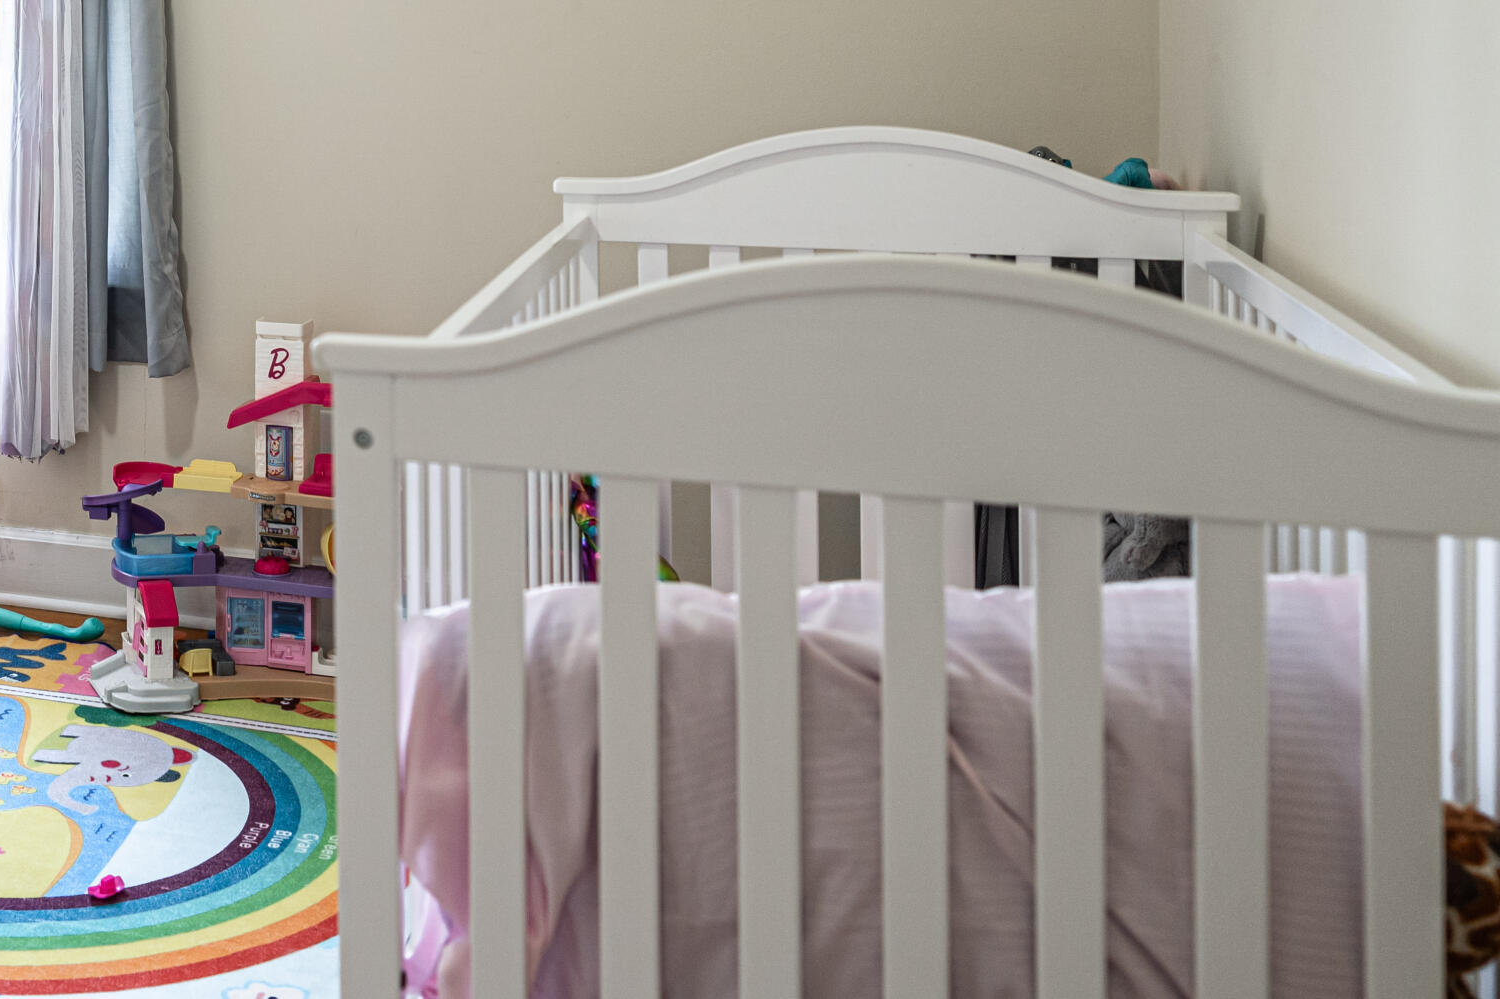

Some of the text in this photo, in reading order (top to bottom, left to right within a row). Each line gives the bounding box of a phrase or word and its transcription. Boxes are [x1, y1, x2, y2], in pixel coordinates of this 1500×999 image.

[268, 348, 290, 380] B
[239, 821, 270, 849] Purple
[267, 829, 293, 849] Blue
[294, 833, 319, 854] Cyan
